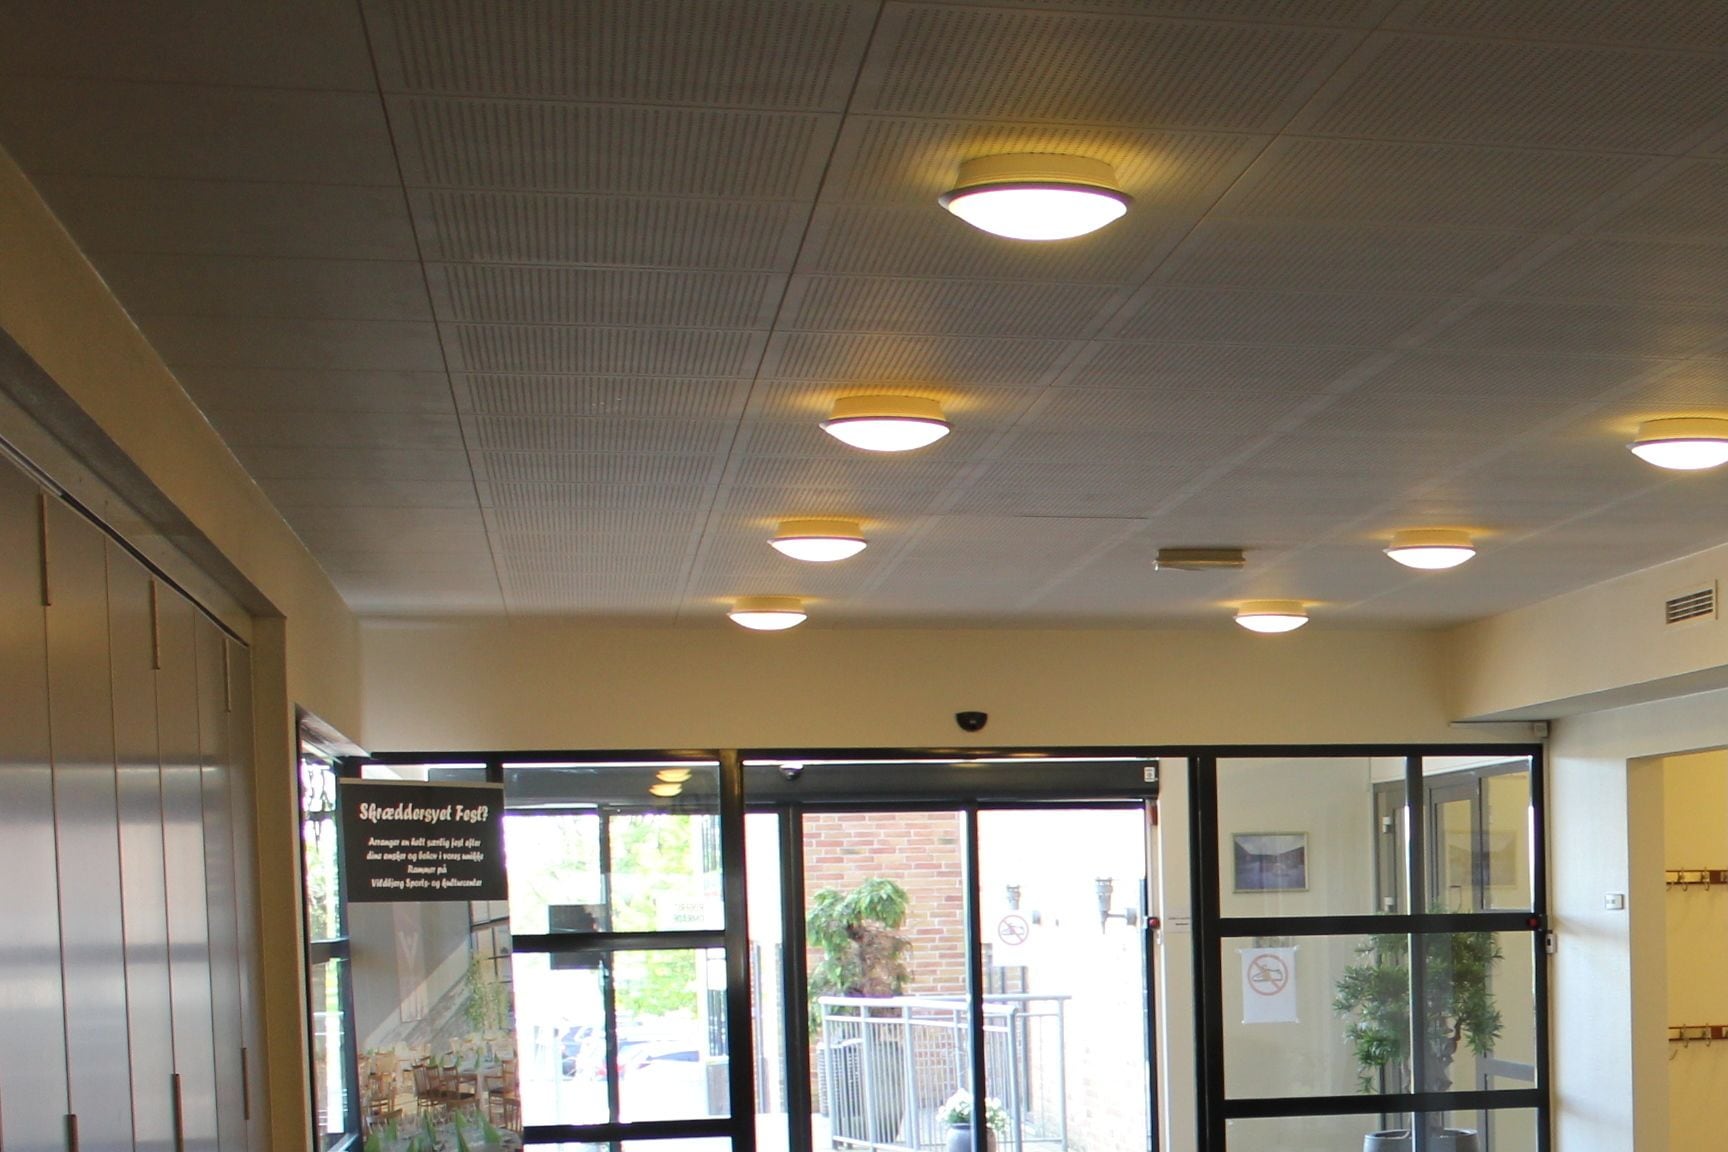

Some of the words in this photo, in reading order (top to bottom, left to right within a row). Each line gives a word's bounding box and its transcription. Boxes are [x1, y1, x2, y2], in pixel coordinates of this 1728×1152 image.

[359, 802, 451, 824] Skræddersyet
[455, 804, 488, 823] Fest?
[407, 852, 417, 862] og
[437, 863, 447, 875] på
[370, 878, 404, 889] Vildbjerg
[431, 880, 440, 889] og
